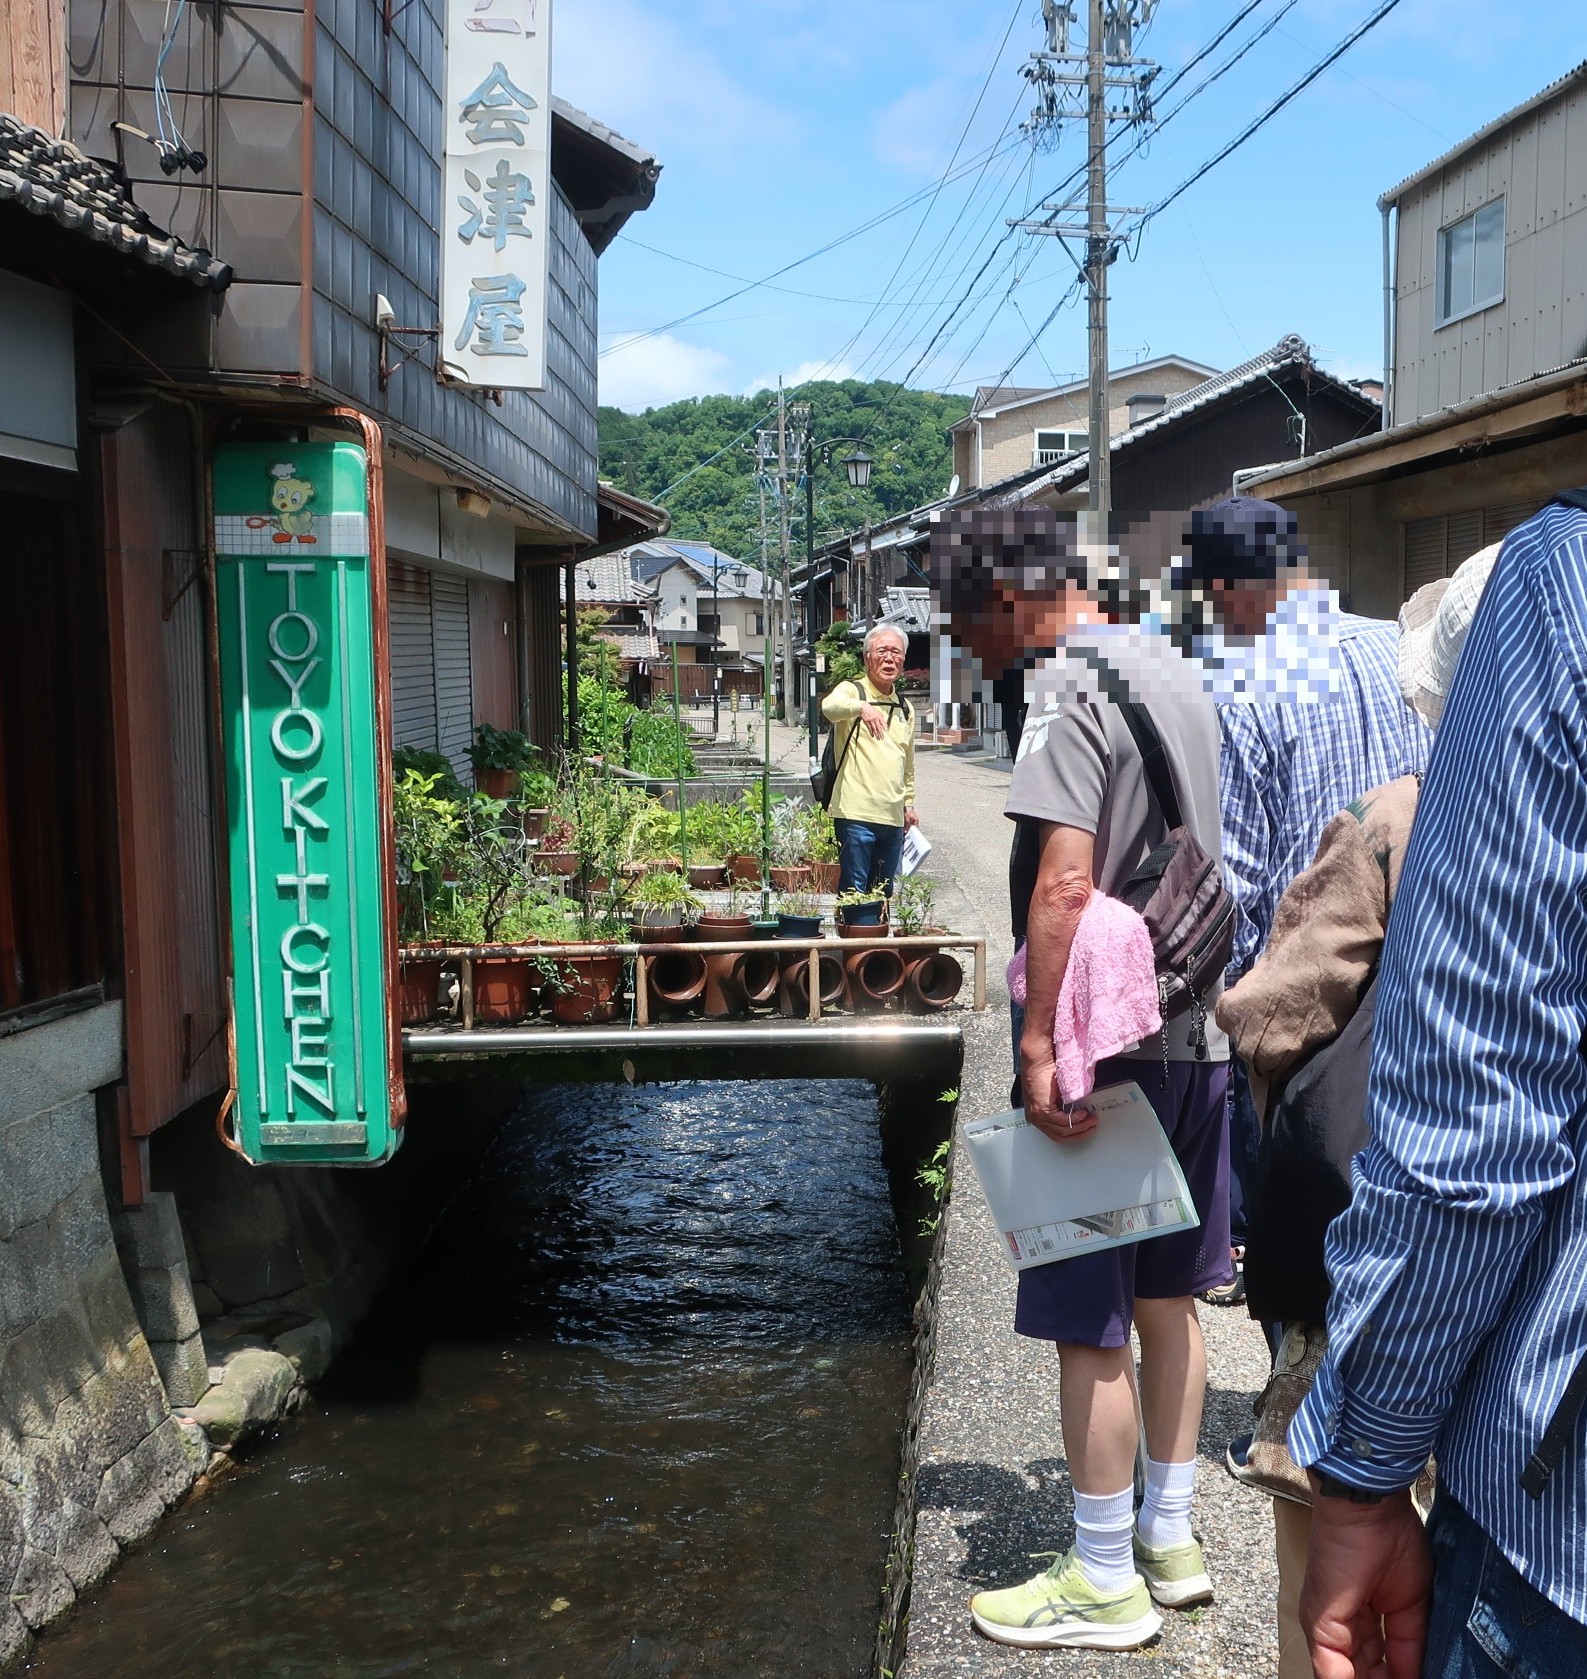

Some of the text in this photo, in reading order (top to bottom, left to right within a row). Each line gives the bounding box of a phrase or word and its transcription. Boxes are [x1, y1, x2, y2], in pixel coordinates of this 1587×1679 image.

[455, 62, 538, 356] 会津屋
[276, 777, 337, 1113] KITCHEN
